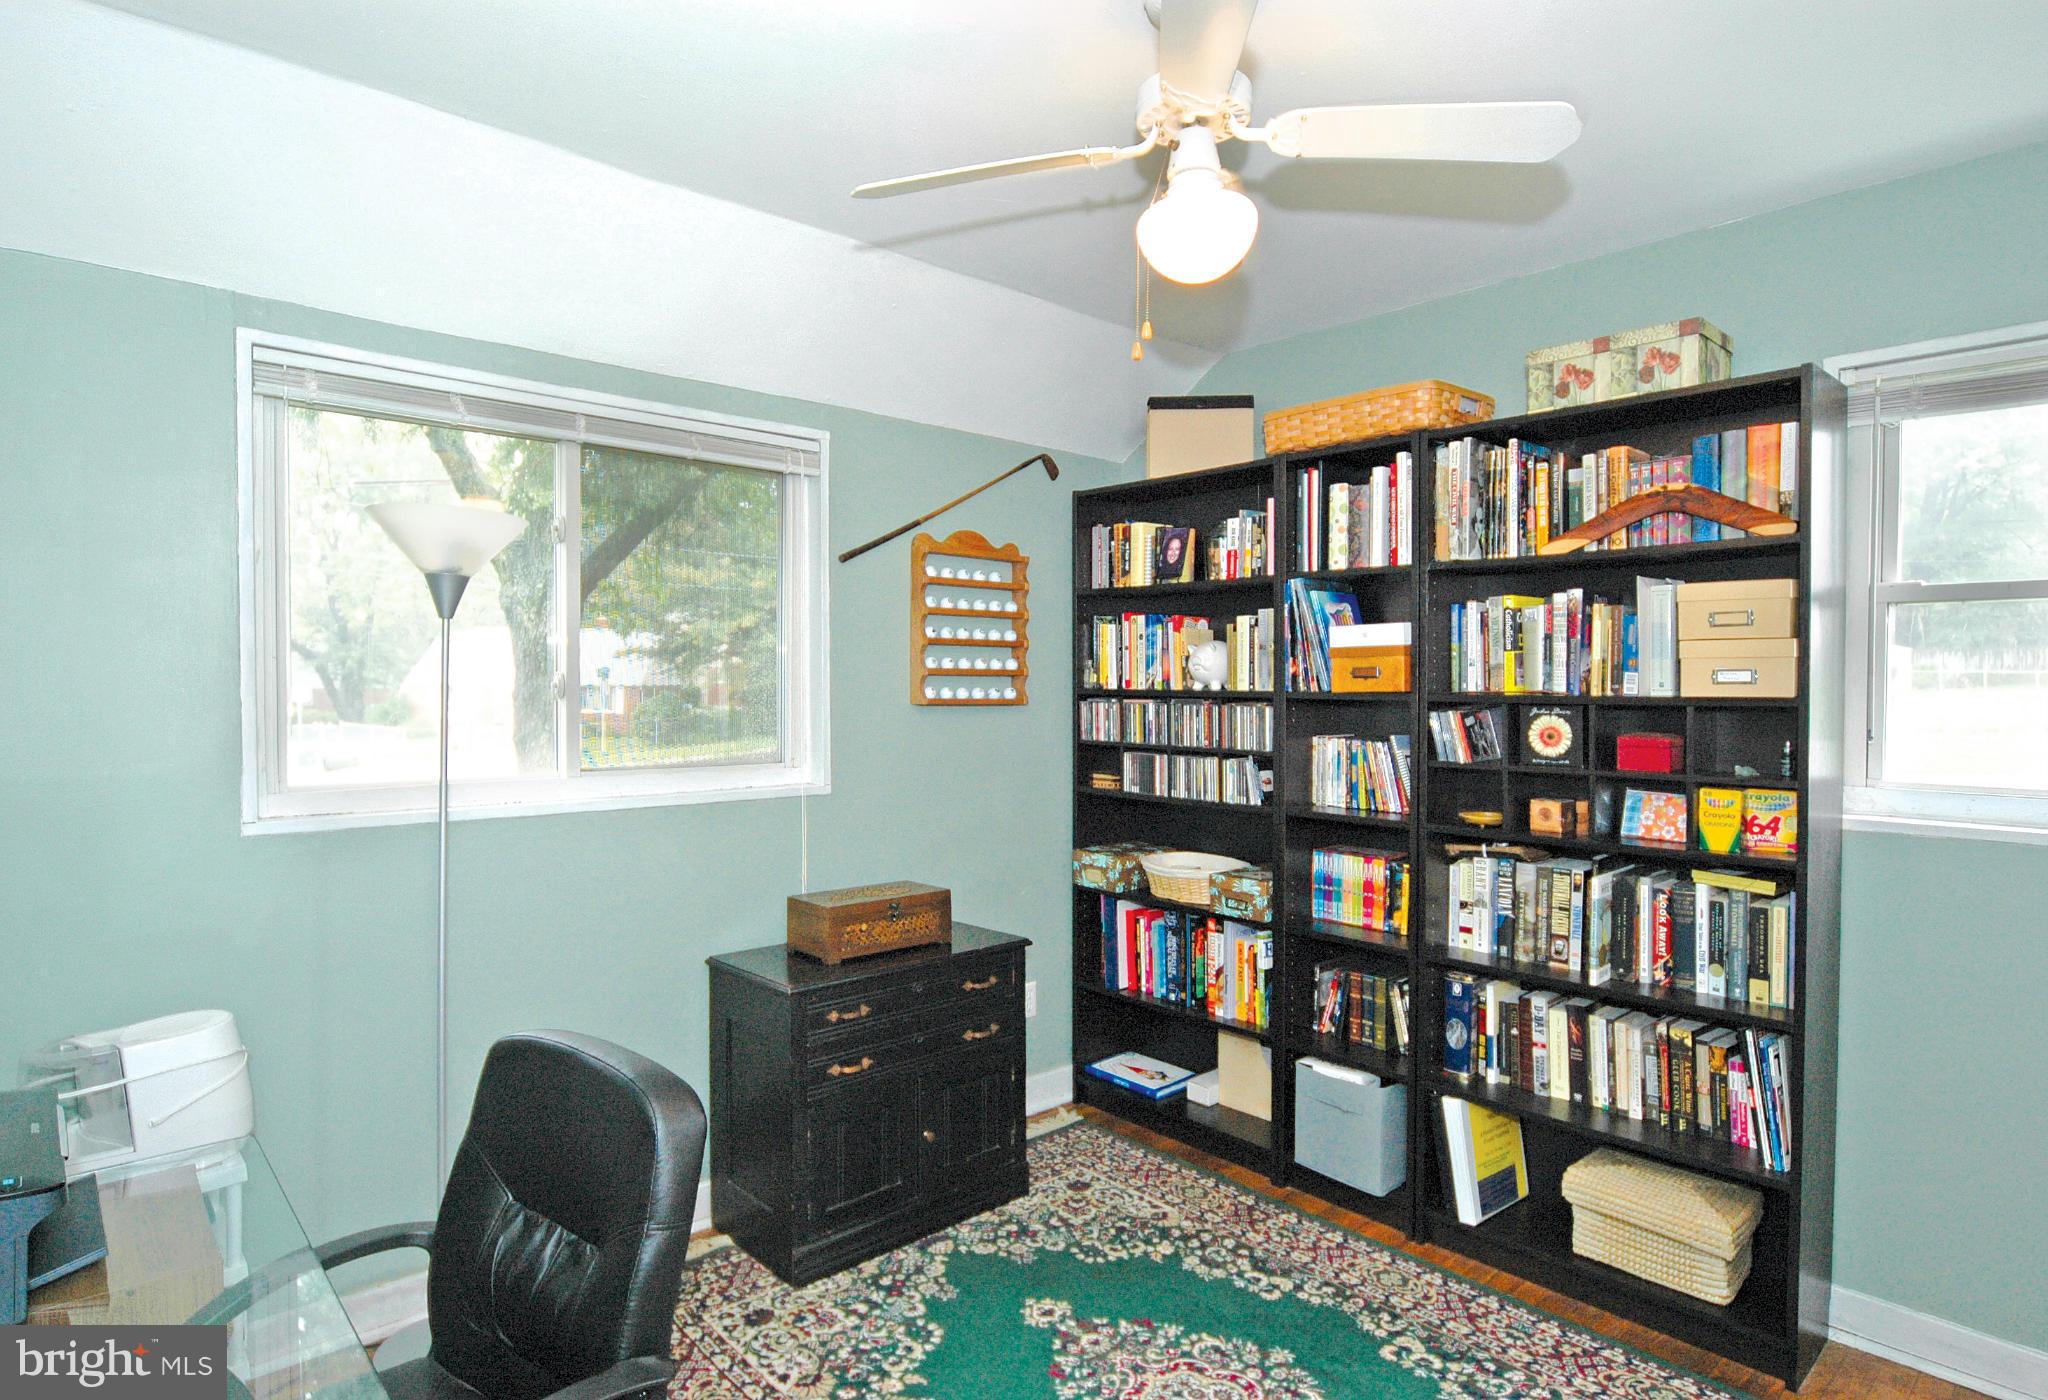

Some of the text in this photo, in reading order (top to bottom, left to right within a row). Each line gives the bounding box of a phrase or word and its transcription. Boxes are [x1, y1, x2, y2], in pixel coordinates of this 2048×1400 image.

[1505, 609, 1513, 650] Catholicism
[1703, 811, 1736, 819] Crayola
[1747, 815, 1781, 835] 64
[1476, 859, 1486, 889] GRANT
[1659, 894, 1667, 957] LOOK AWAY!
[1534, 1005, 1544, 1035] D-DAY
